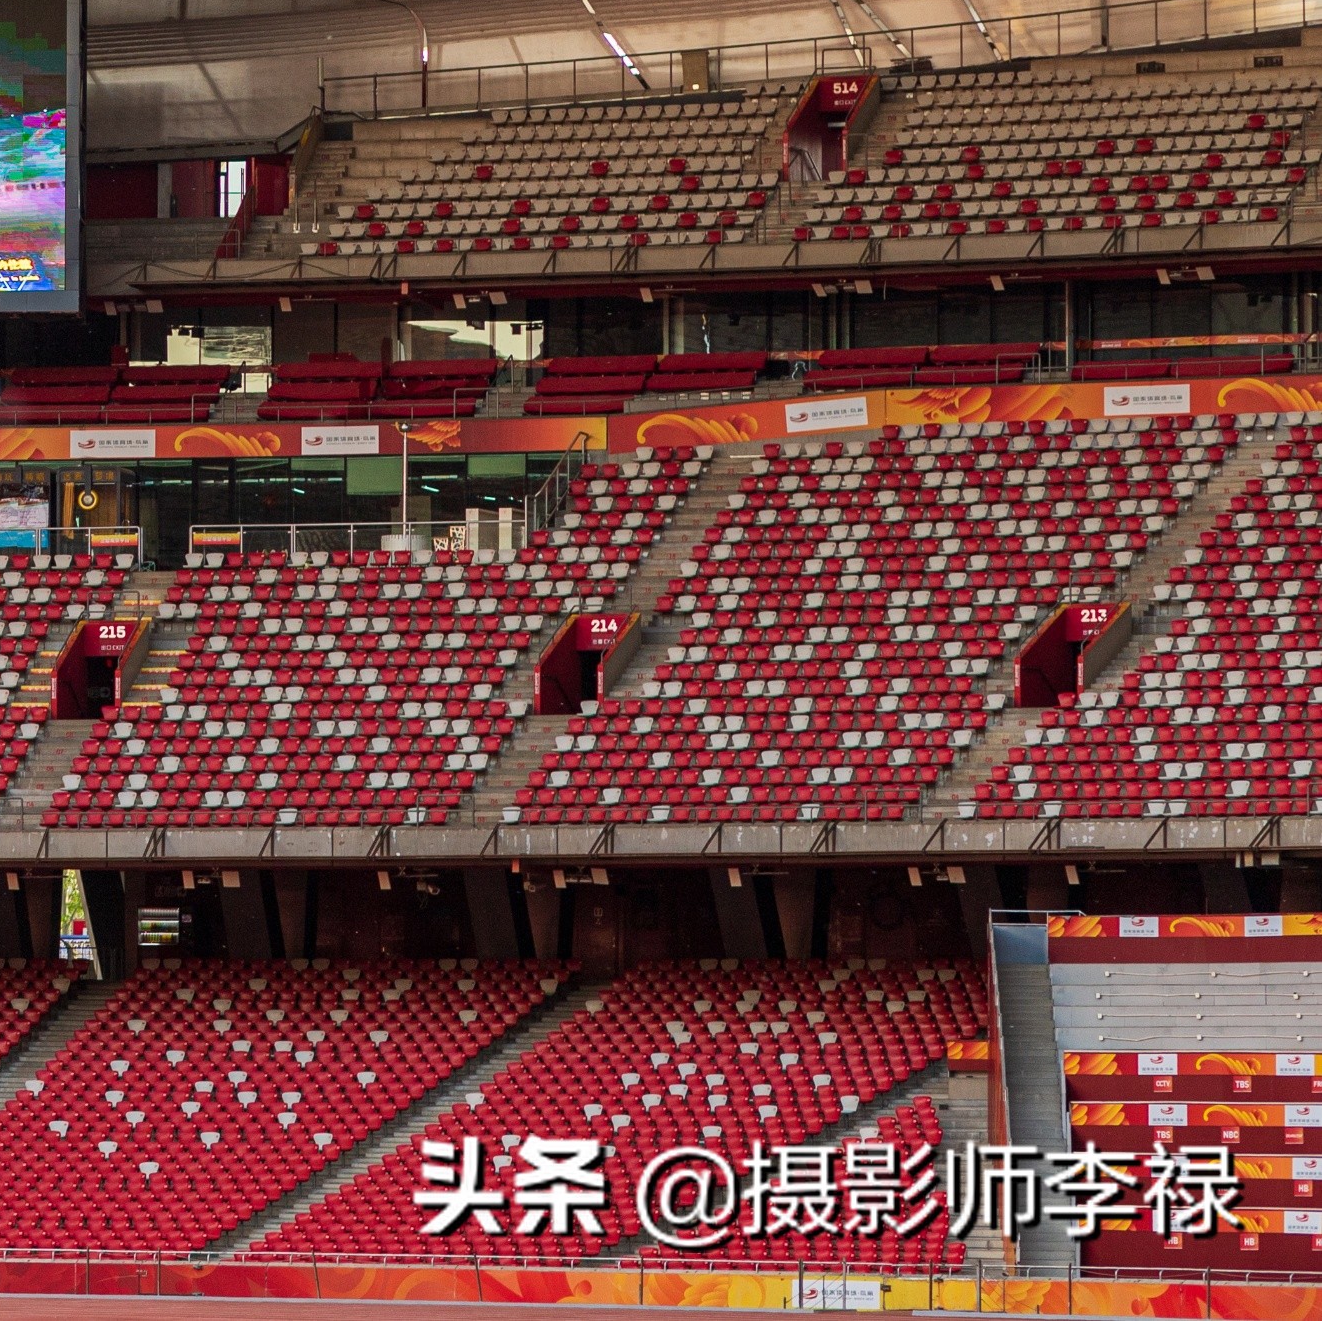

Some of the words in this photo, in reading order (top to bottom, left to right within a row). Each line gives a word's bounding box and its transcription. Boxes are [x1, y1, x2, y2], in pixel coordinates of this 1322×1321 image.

[833, 81, 859, 94] 514
[1080, 609, 1107, 623] 213
[591, 619, 618, 633] 214
[99, 625, 126, 639] 215
[1235, 1080, 1249, 1088] TBS
[1156, 1130, 1171, 1139] TBS
[1222, 1130, 1239, 1139] NBC
[1243, 1237, 1255, 1246] HB
